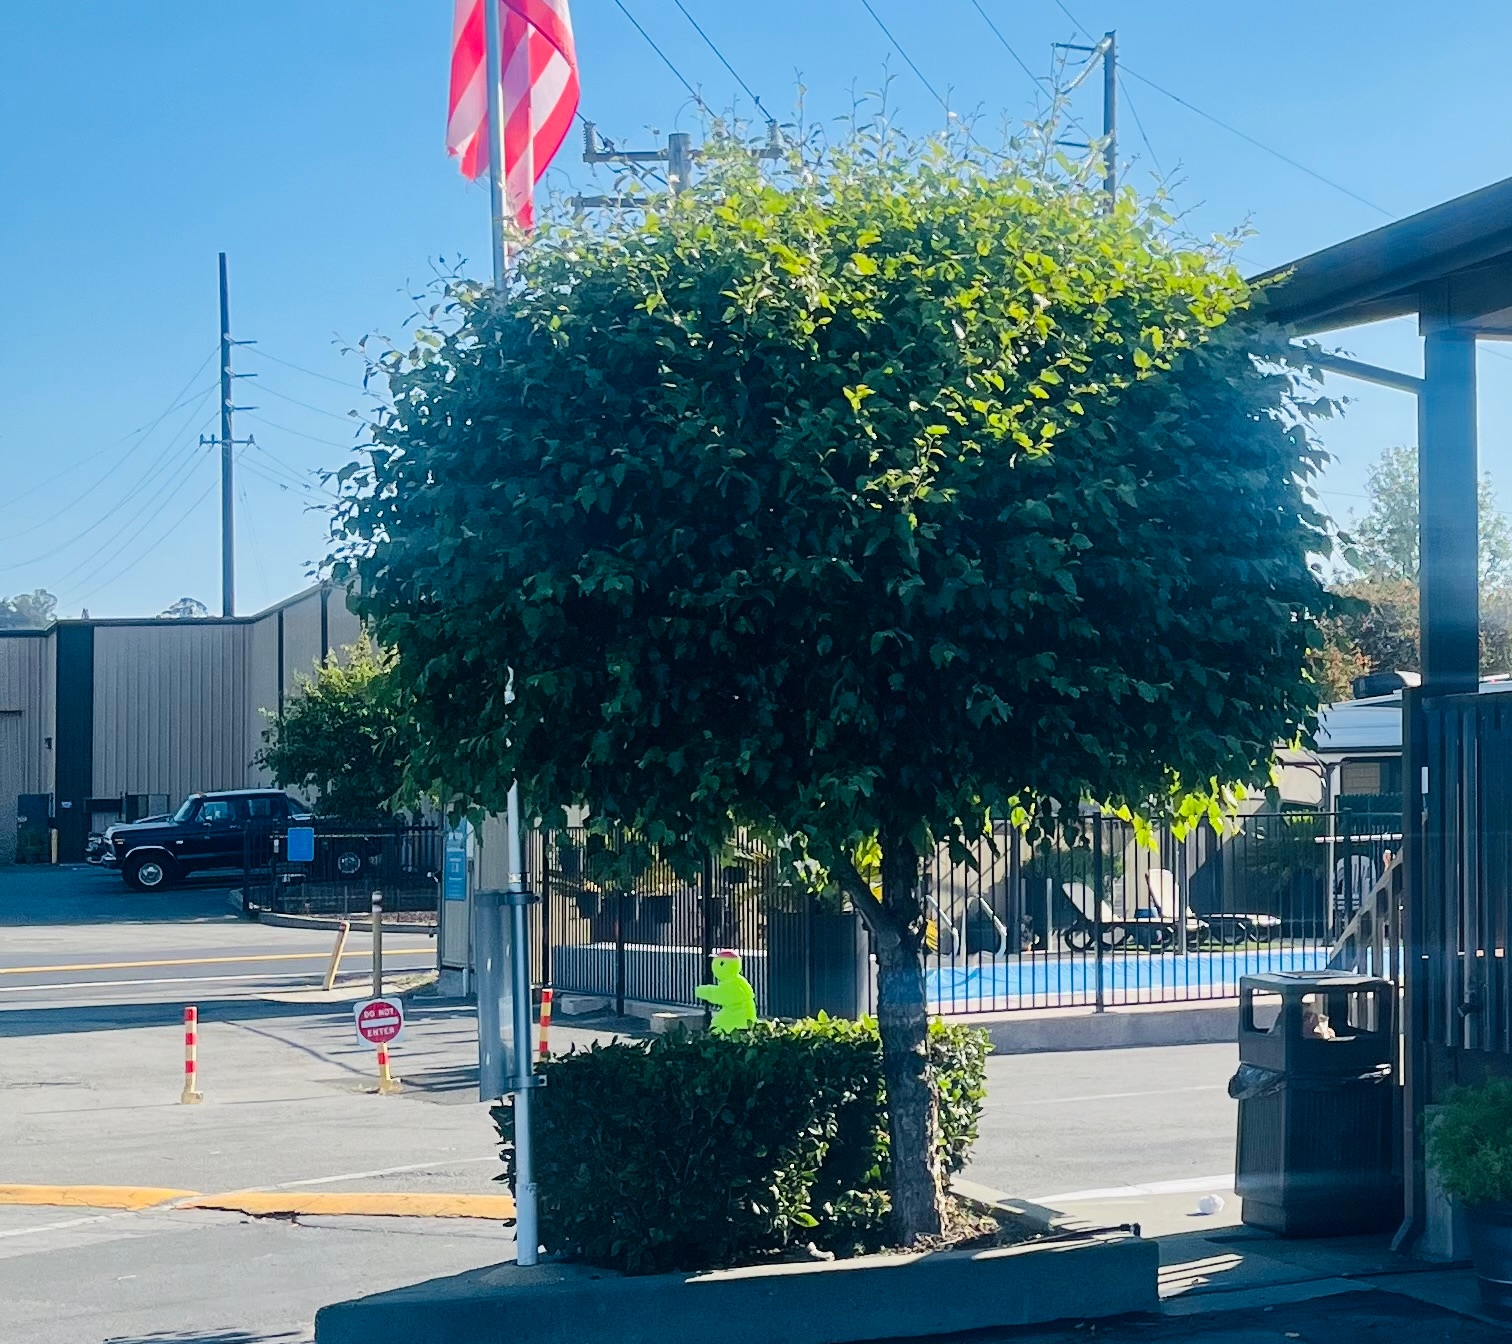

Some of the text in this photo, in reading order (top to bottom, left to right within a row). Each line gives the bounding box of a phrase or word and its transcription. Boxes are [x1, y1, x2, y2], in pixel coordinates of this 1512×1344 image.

[364, 1008, 394, 1018] DO NOT
[367, 1027, 395, 1037] ENTER
